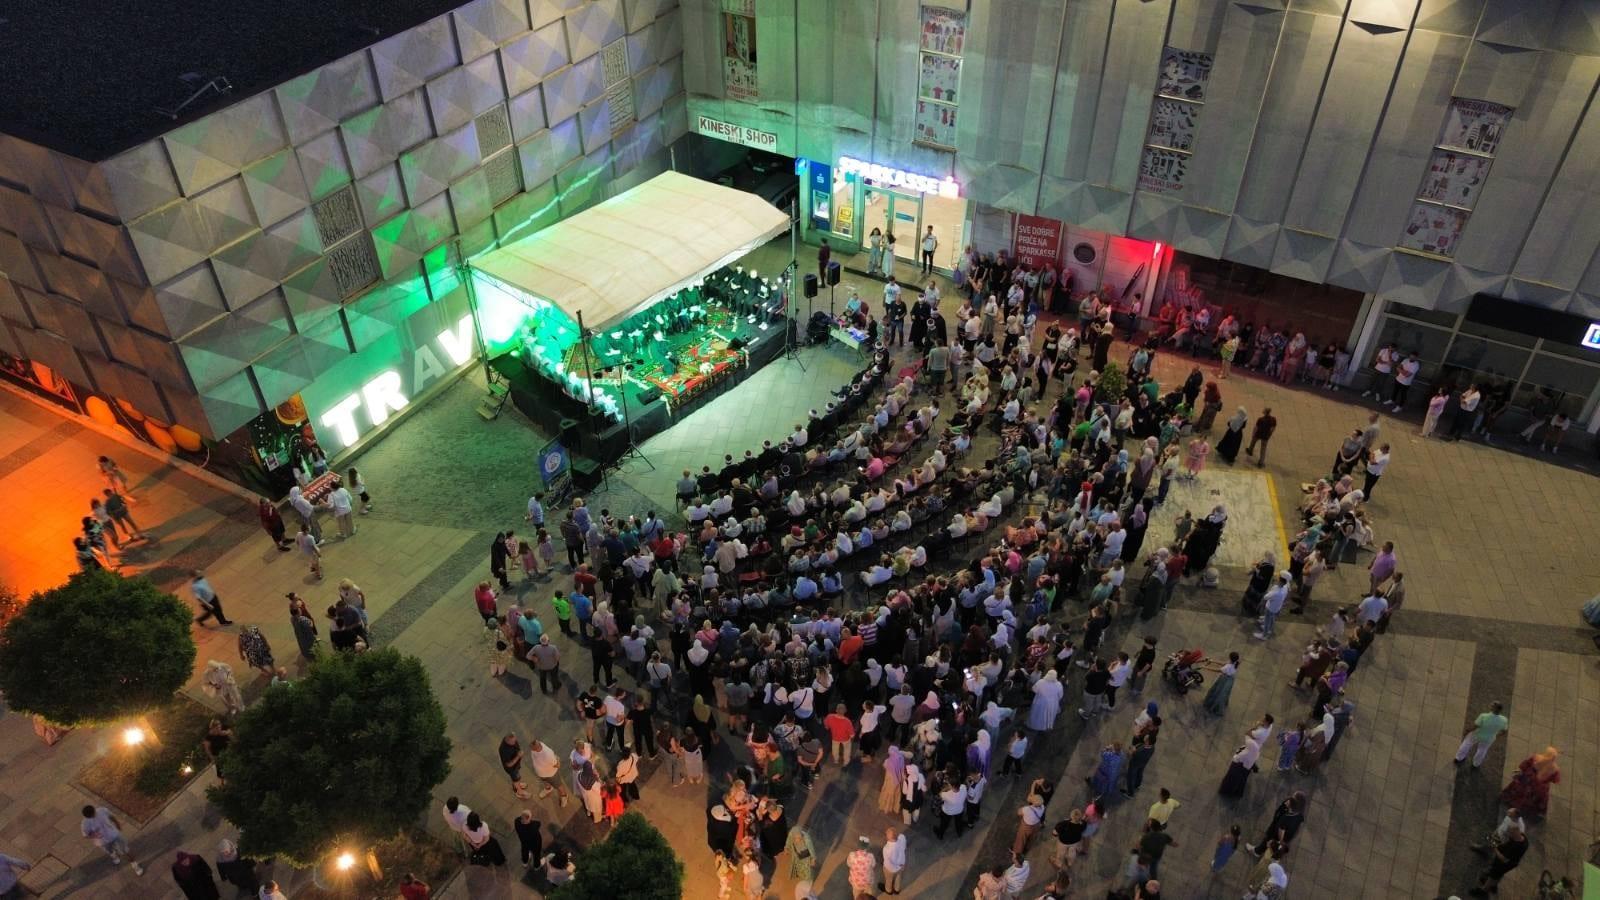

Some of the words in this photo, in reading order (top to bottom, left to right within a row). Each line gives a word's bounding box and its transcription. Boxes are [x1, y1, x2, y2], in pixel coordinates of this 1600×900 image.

[700, 118, 742, 138] KINESKI
[746, 129, 775, 145] SHOP
[1018, 225, 1031, 234] SVE
[1031, 226, 1055, 237] DOBRE
[1037, 238, 1048, 247] NA
[1018, 245, 1056, 257] SPARKASSE
